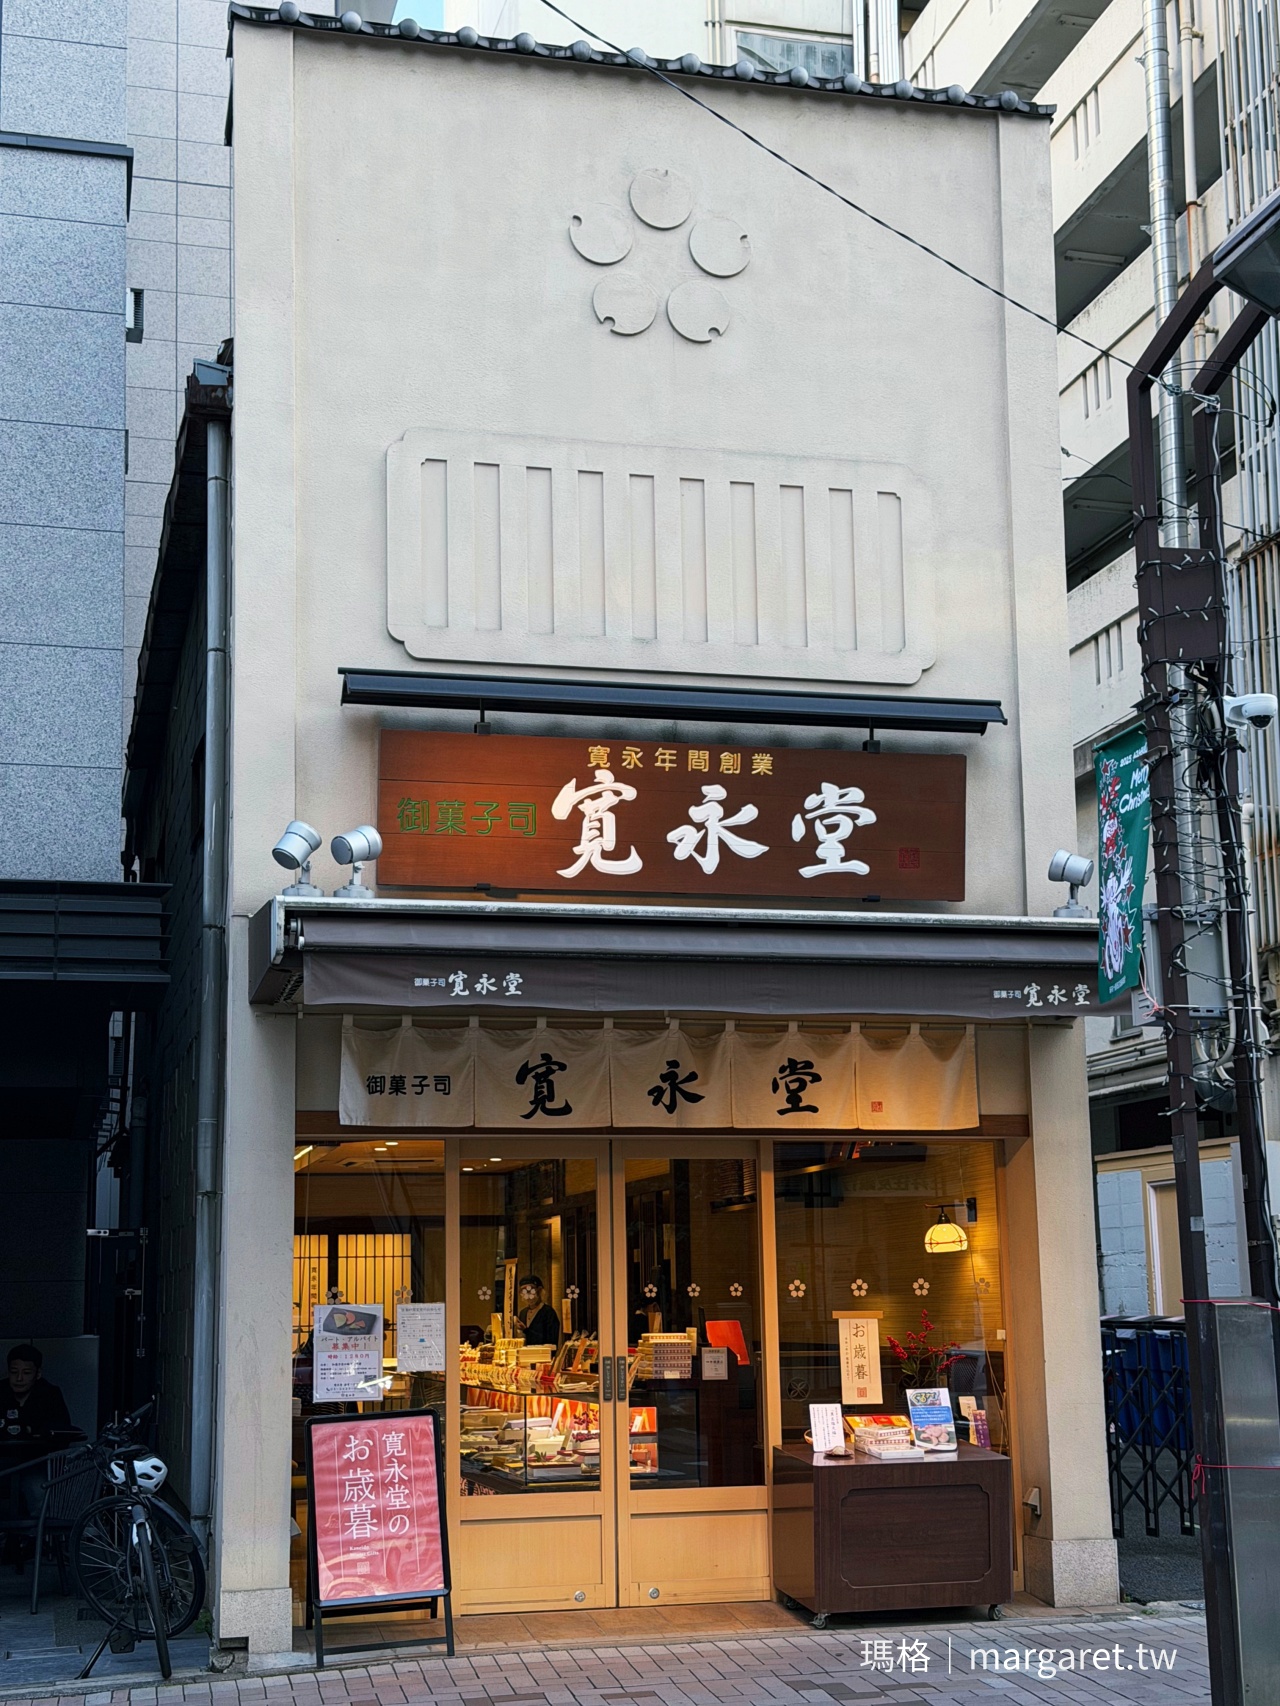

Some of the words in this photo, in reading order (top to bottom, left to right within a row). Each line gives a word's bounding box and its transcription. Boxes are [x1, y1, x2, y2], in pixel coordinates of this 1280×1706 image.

[397, 797, 537, 837] 御菓子司
[414, 978, 446, 987] 御菓子司
[993, 990, 1022, 999] 御菓子司
[366, 1074, 451, 1096] 御菓子司
[852, 1323, 869, 1380] お歳暮
[342, 1435, 378, 1540] お歳暮
[382, 1431, 411, 1535] 寛永堂の
